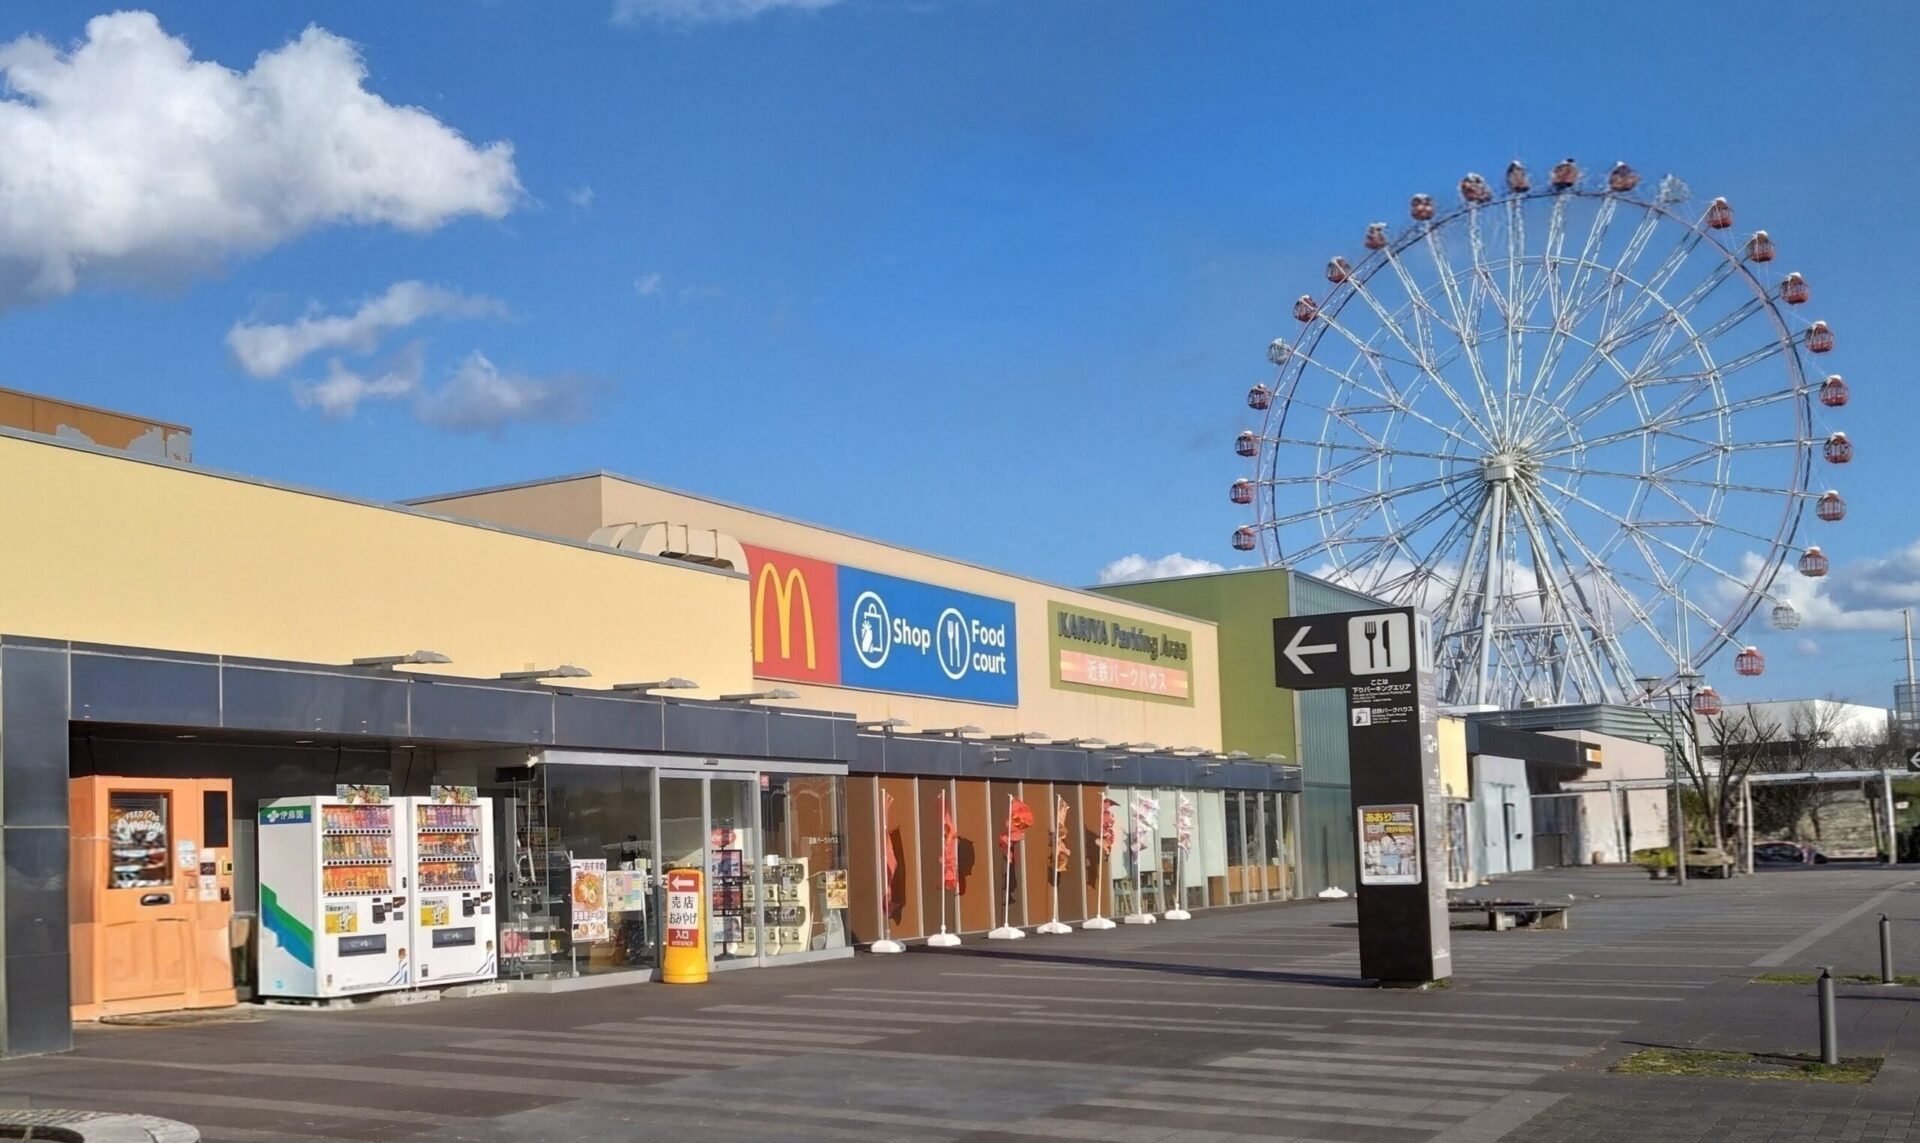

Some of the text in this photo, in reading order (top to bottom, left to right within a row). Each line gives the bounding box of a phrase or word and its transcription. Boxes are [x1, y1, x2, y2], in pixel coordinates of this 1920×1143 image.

[893, 617, 931, 655] Shop
[972, 619, 1006, 648] Food
[1111, 622, 1158, 661] Parking
[1160, 634, 1187, 661] Area
[973, 652, 1007, 675] court
[1087, 659, 1168, 690] 近鉄パークハウス
[1352, 683, 1412, 694] 下りパーキングエリア
[1370, 678, 1389, 686] ここは
[669, 912, 698, 925] おみやげ
[675, 929, 690, 940] 入口
